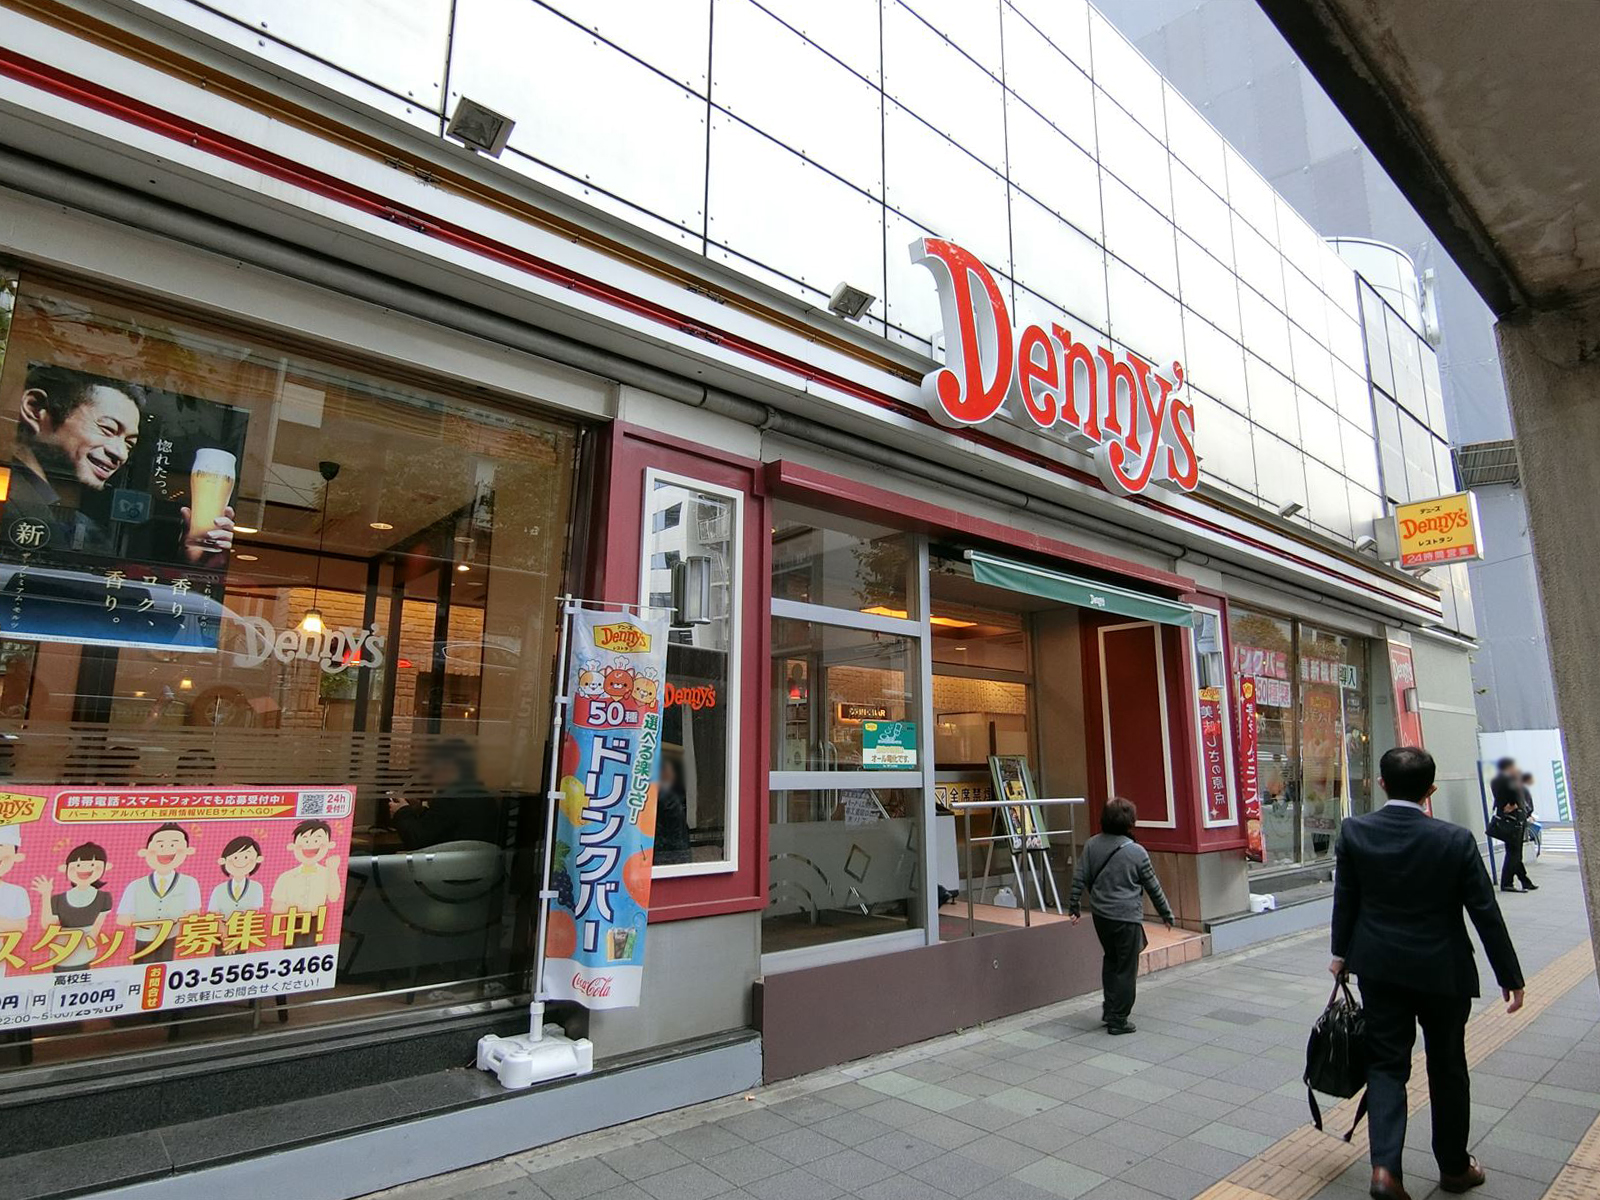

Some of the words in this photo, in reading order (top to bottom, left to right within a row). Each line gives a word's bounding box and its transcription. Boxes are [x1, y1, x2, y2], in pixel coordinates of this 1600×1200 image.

[921, 236, 1199, 494] Denny's
[16, 522, 44, 546] 新
[1399, 508, 1469, 540] Denny's
[1418, 537, 1453, 547] レストラン
[104, 570, 126, 623] 香り。
[233, 616, 385, 674] Denny's
[601, 627, 646, 648] Denny's
[664, 682, 717, 710] Denny's
[326, 794, 346, 805] 24h
[575, 735, 630, 953] ドリンクバー
[54, 973, 92, 986] 高校生
[168, 954, 335, 991] 03-5565-3466
[32, 994, 46, 1006] 円
[60, 988, 115, 1007] 1200円
[128, 984, 141, 996] 円
[147, 967, 162, 1007] お問合せ
[174, 978, 320, 1005] お気軽にお問合せください!
